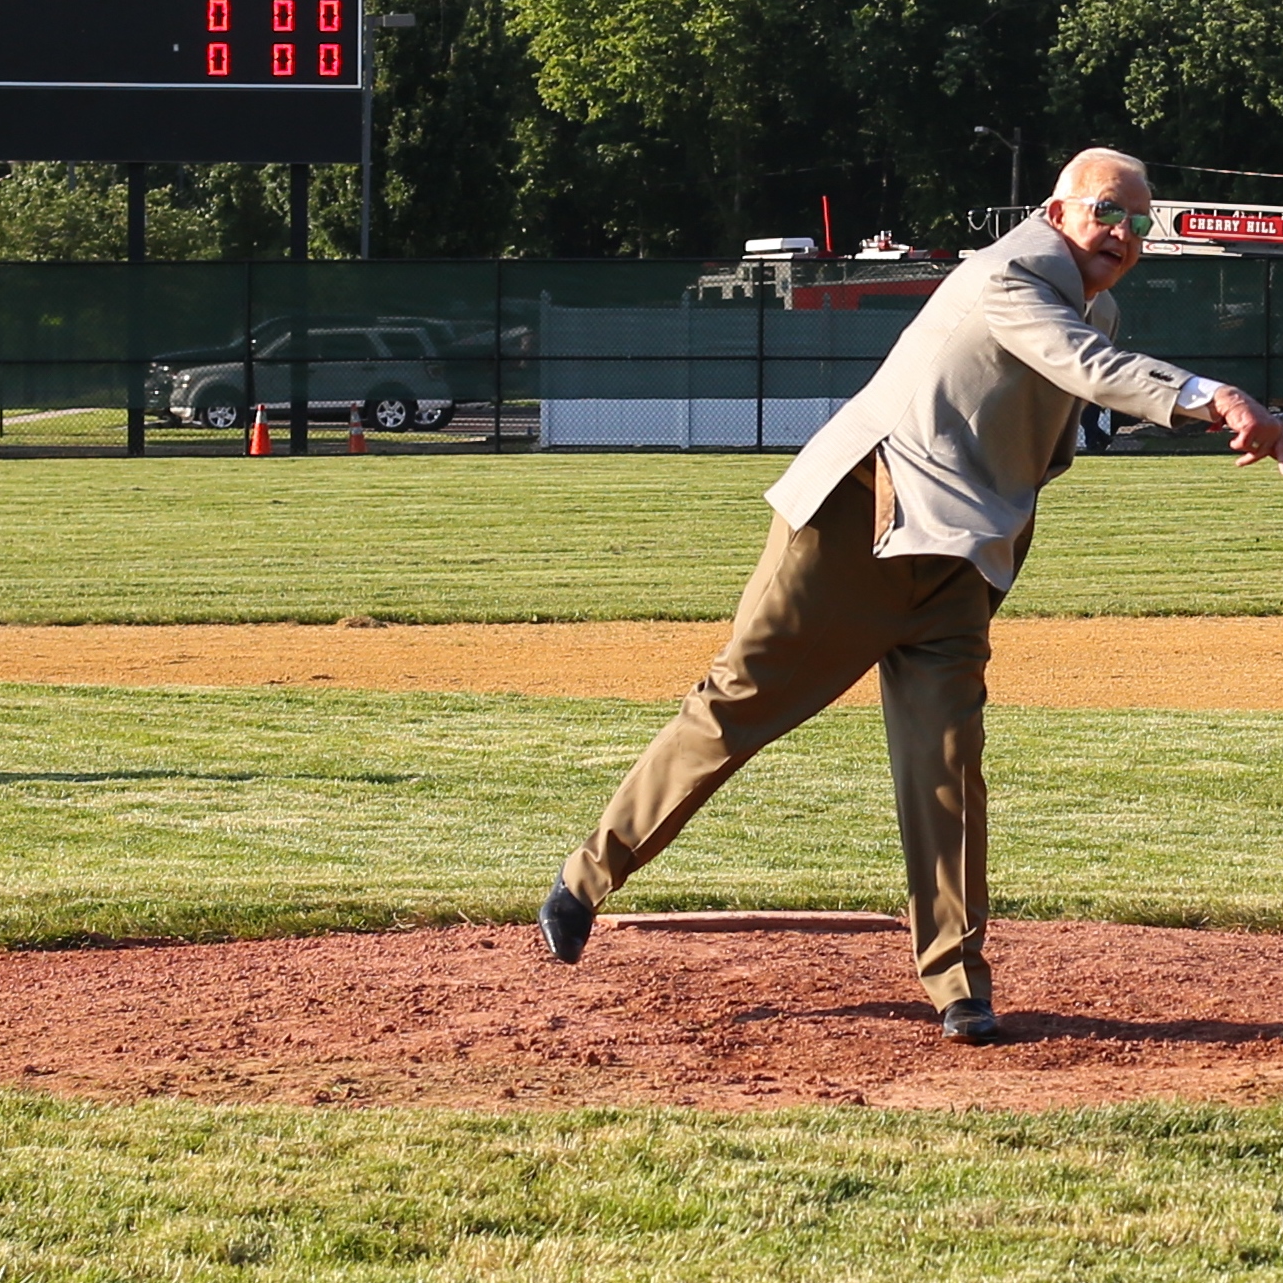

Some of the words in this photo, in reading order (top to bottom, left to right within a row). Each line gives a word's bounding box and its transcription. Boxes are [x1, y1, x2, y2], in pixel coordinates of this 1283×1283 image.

[207, 0, 230, 31] 0
[273, 0, 295, 31] 0
[319, 0, 342, 31] 0
[207, 43, 230, 75] 0
[273, 43, 295, 75] 0
[319, 43, 342, 75] 0
[1189, 218, 1240, 233] CHERRY
[1246, 222, 1276, 235] HILL
